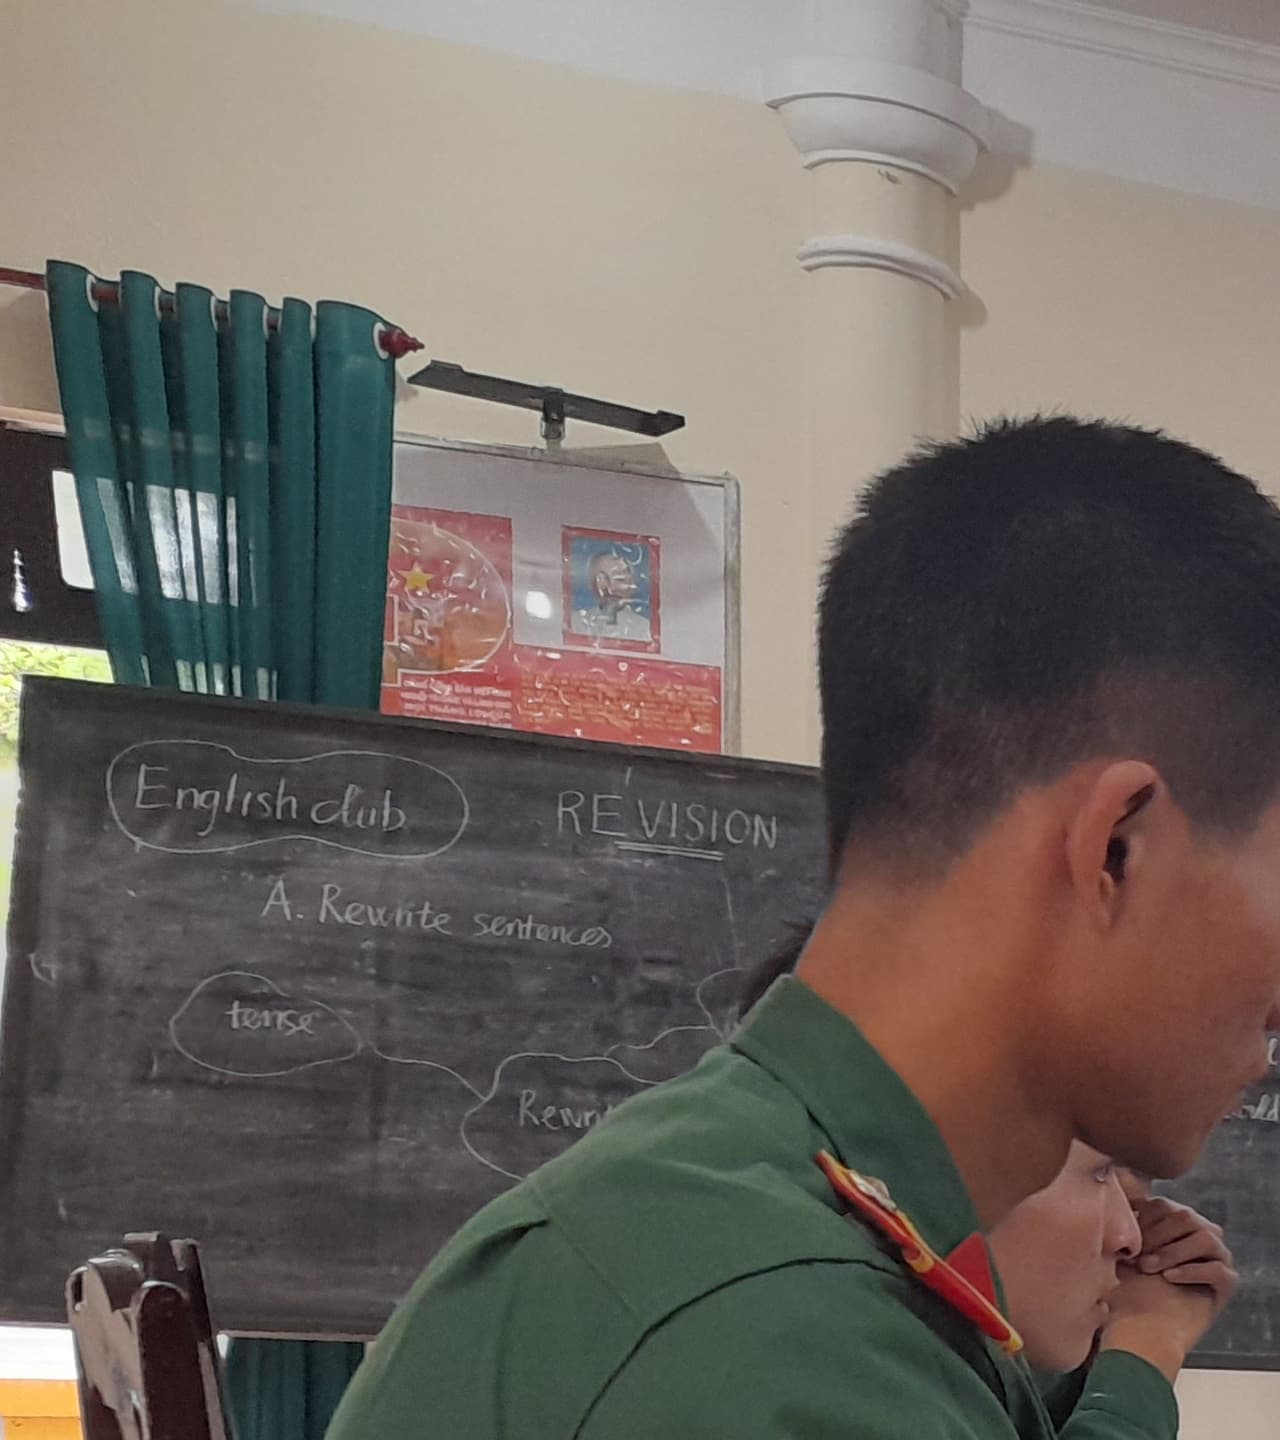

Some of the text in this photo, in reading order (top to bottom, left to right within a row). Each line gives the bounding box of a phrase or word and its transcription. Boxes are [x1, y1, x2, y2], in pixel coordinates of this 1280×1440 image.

[134, 762, 298, 837] English
[557, 790, 778, 849] REVISION
[318, 883, 454, 936] Rewrite
